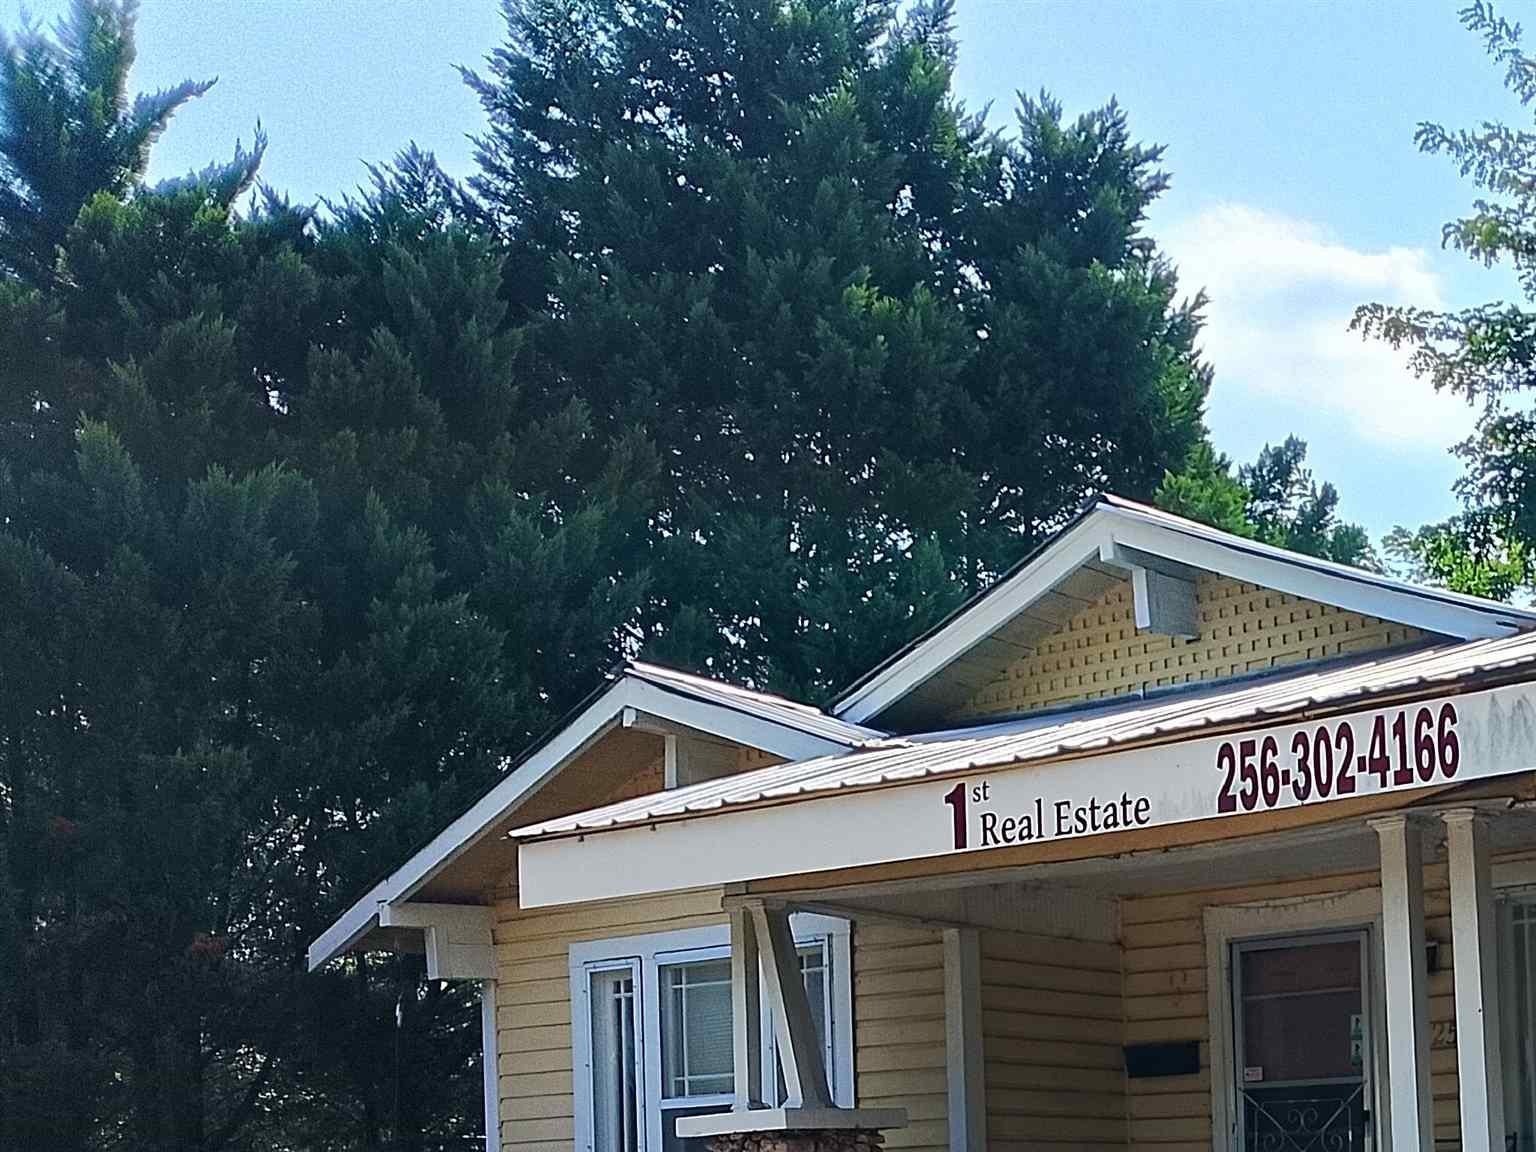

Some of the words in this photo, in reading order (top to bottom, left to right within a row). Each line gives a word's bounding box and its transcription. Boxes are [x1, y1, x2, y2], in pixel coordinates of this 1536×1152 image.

[1216, 702, 1460, 814] 256-302-4166
[979, 798, 1045, 847] Real
[1053, 791, 1151, 837] Estate
